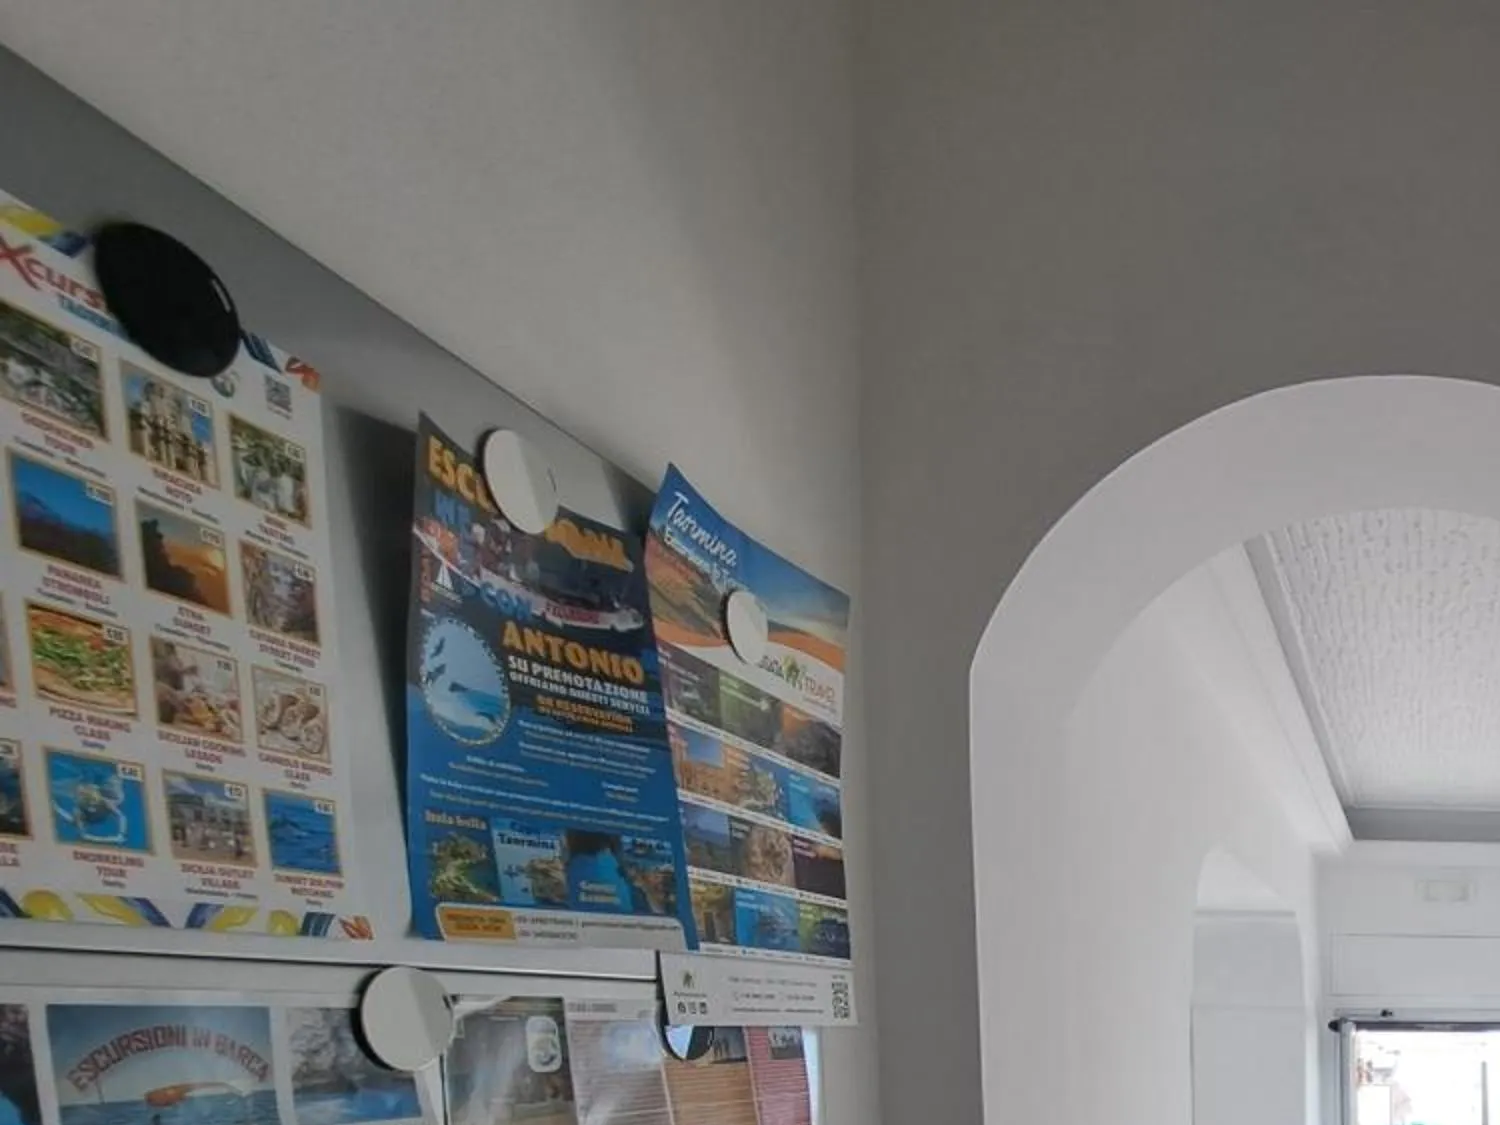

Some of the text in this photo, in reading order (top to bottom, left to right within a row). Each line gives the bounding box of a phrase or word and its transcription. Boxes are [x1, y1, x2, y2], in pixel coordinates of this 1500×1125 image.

[502, 619, 645, 685] ANTONIO
[507, 654, 649, 704] SU PRENOTAZIONE
[50, 707, 86, 724] PIZZA
[73, 724, 111, 741] CLASS
[66, 1024, 187, 1092] ESCURSIONI
